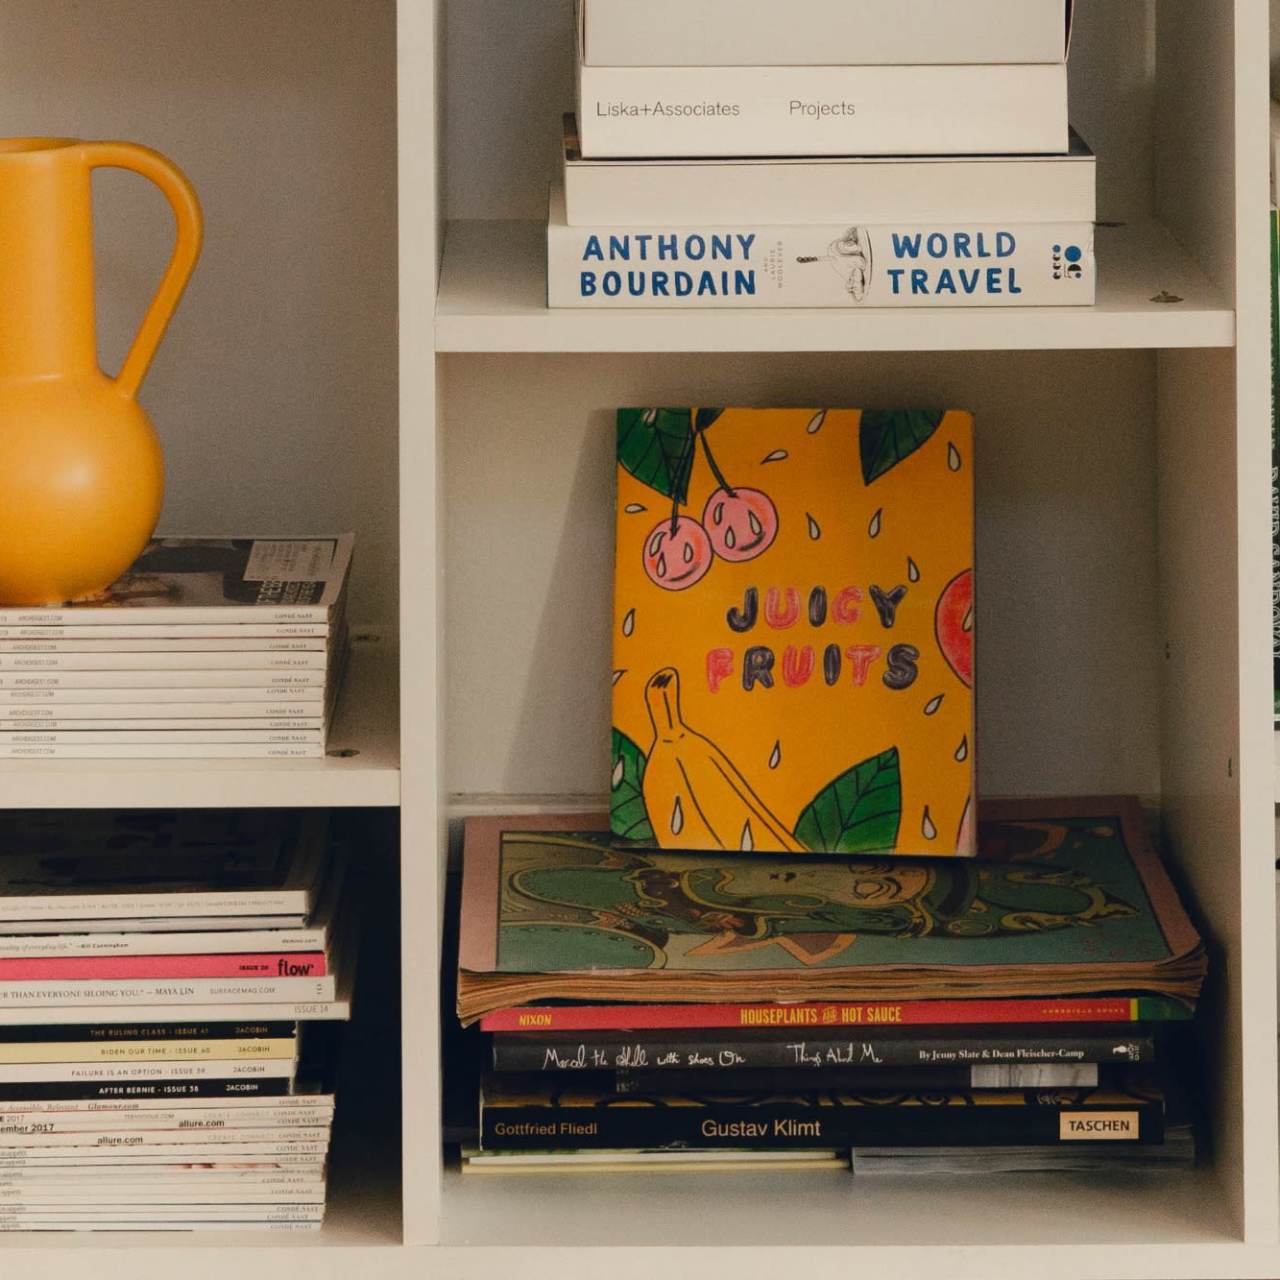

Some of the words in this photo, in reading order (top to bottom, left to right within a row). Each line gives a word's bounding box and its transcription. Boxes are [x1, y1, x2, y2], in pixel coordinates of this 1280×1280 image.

[596, 100, 740, 118] Liska+Associates
[789, 100, 855, 120] Projects
[582, 232, 756, 262] ANTHONY
[891, 231, 1017, 259] WORLD
[580, 270, 756, 297] BOURDAIN
[887, 267, 1022, 295] TRAVEL
[726, 584, 908, 633] JUICY
[706, 643, 919, 694] FRUITS
[519, 1015, 552, 1026] NIXON
[740, 1008, 818, 1025] HOUSEPLANTS
[841, 1008, 863, 1023] HOT
[867, 1007, 902, 1022] SAUCE
[178, 1119, 225, 1128] allure.com
[494, 1121, 554, 1136] Gottfried
[560, 1122, 598, 1135] Fliedl
[702, 1120, 768, 1137] Gustav
[774, 1119, 821, 1137] Klimt
[1069, 1120, 1130, 1131] TASCHEN
[97, 1136, 143, 1145] allure.com
